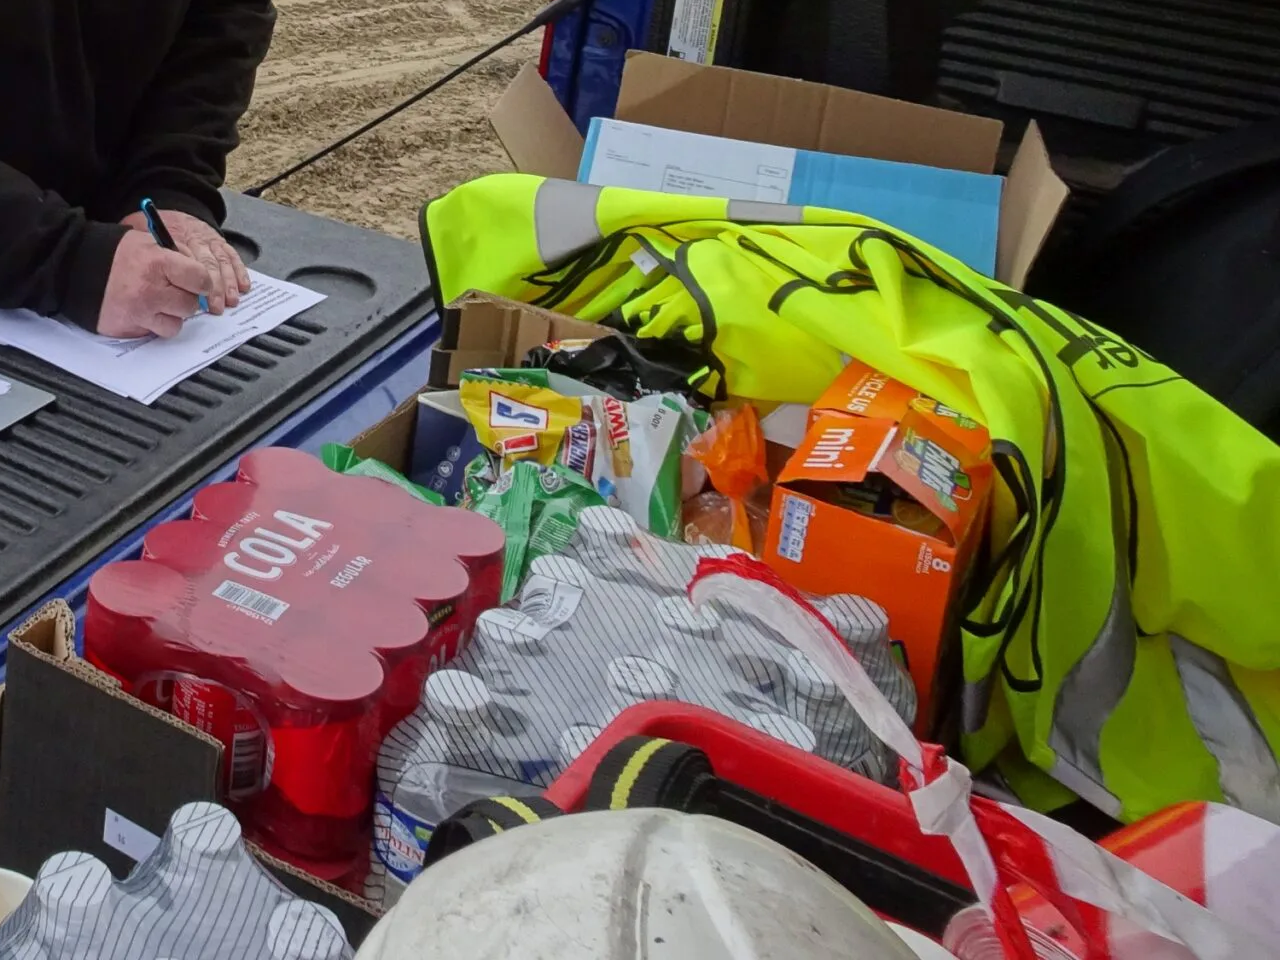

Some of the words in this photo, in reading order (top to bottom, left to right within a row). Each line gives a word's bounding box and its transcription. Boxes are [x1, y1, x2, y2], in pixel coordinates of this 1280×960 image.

[650, 415, 662, 429] 400
[847, 398, 871, 413] US
[568, 423, 589, 474] NICKER
[803, 427, 855, 469] mini
[920, 440, 960, 495] FANTA
[223, 509, 334, 582] COLA
[330, 555, 373, 588] REGULAR
[931, 557, 951, 573] 8
